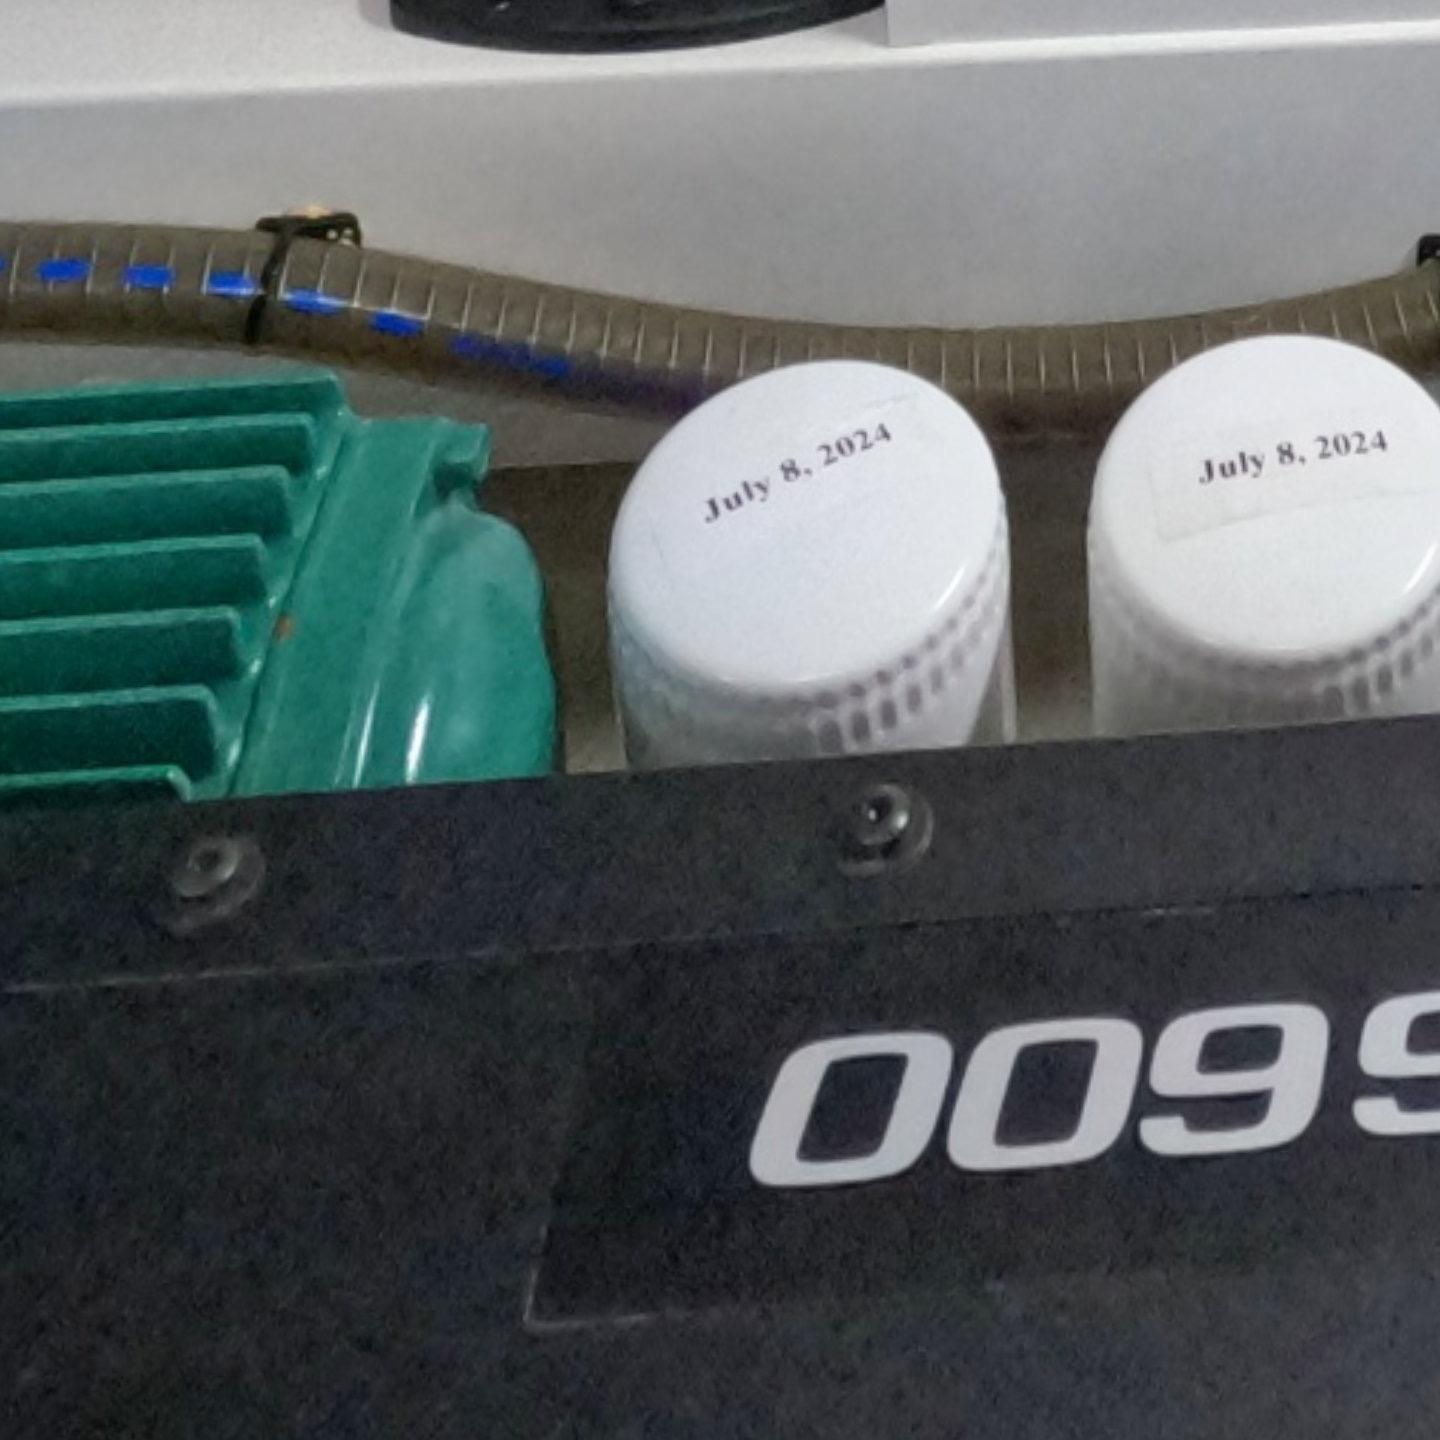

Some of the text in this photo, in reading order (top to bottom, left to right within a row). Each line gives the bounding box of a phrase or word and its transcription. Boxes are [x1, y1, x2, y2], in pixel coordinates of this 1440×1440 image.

[704, 422, 892, 523] July 8, 2024
[1198, 429, 1387, 484] July 8, 2024
